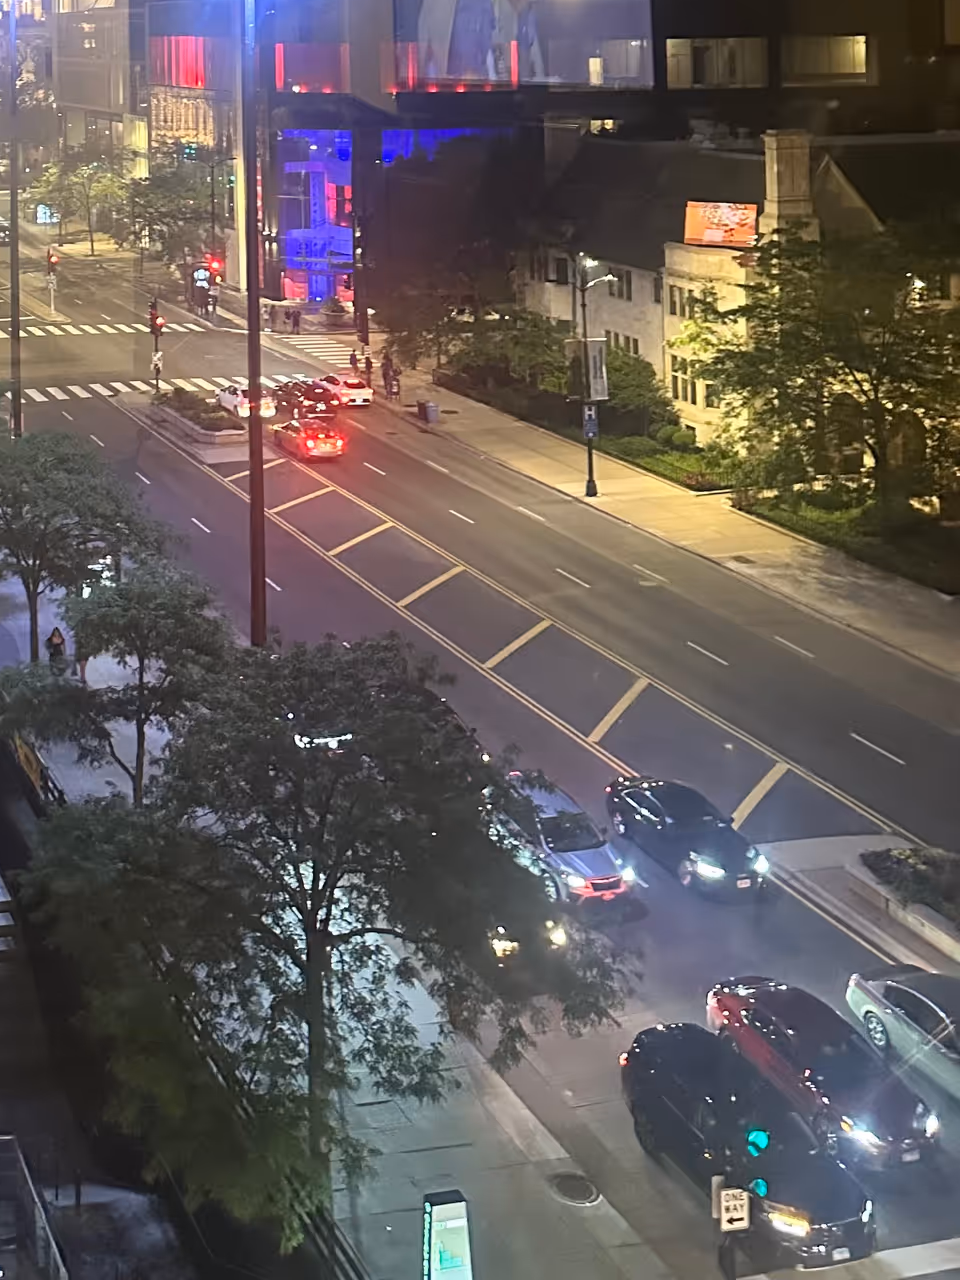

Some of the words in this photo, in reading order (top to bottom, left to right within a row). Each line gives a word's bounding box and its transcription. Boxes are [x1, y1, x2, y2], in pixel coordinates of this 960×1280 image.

[584, 406, 596, 420] H
[724, 1192, 745, 1202] ONE
[724, 1202, 745, 1213] WAY
